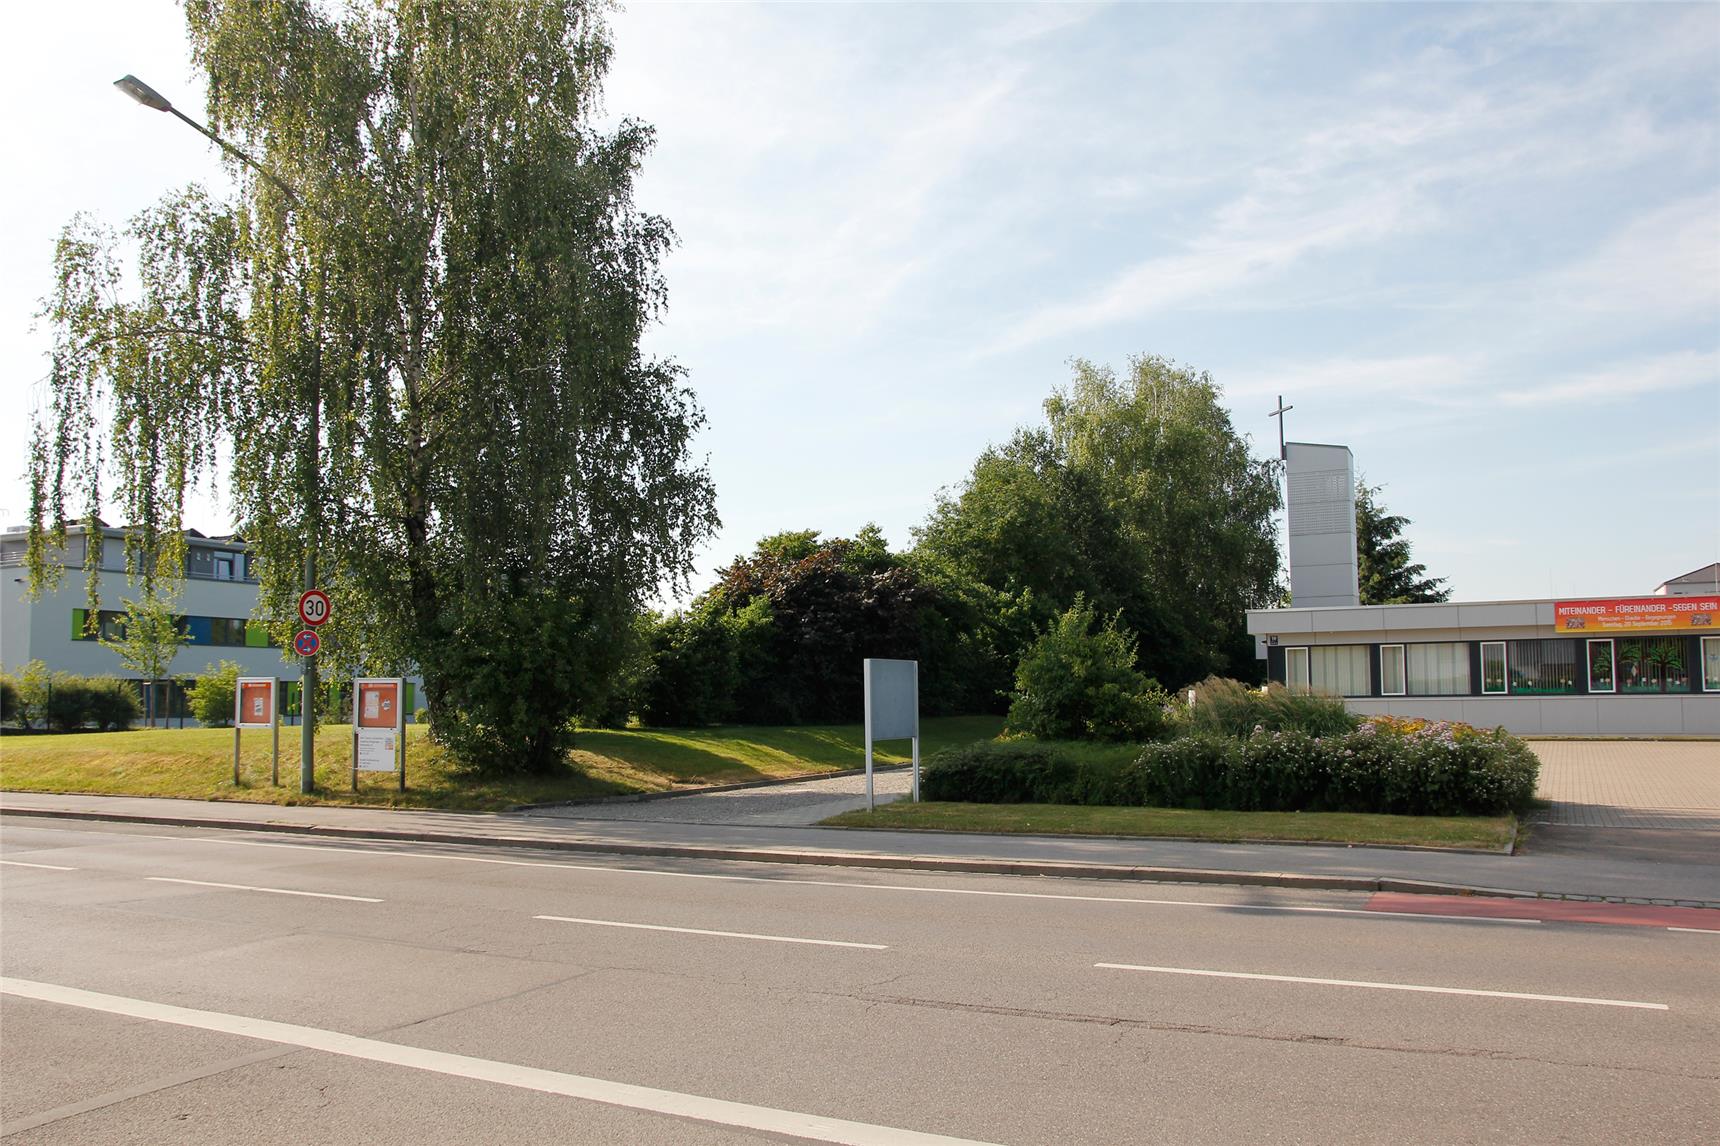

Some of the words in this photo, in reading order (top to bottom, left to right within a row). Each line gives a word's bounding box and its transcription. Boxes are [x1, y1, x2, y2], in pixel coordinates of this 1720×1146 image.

[306, 600, 324, 617] 30
[1559, 606, 1606, 615] MITEINANDER
[1615, 604, 1666, 613] FÜREINANDER
[1700, 602, 1718, 610] SEIN
